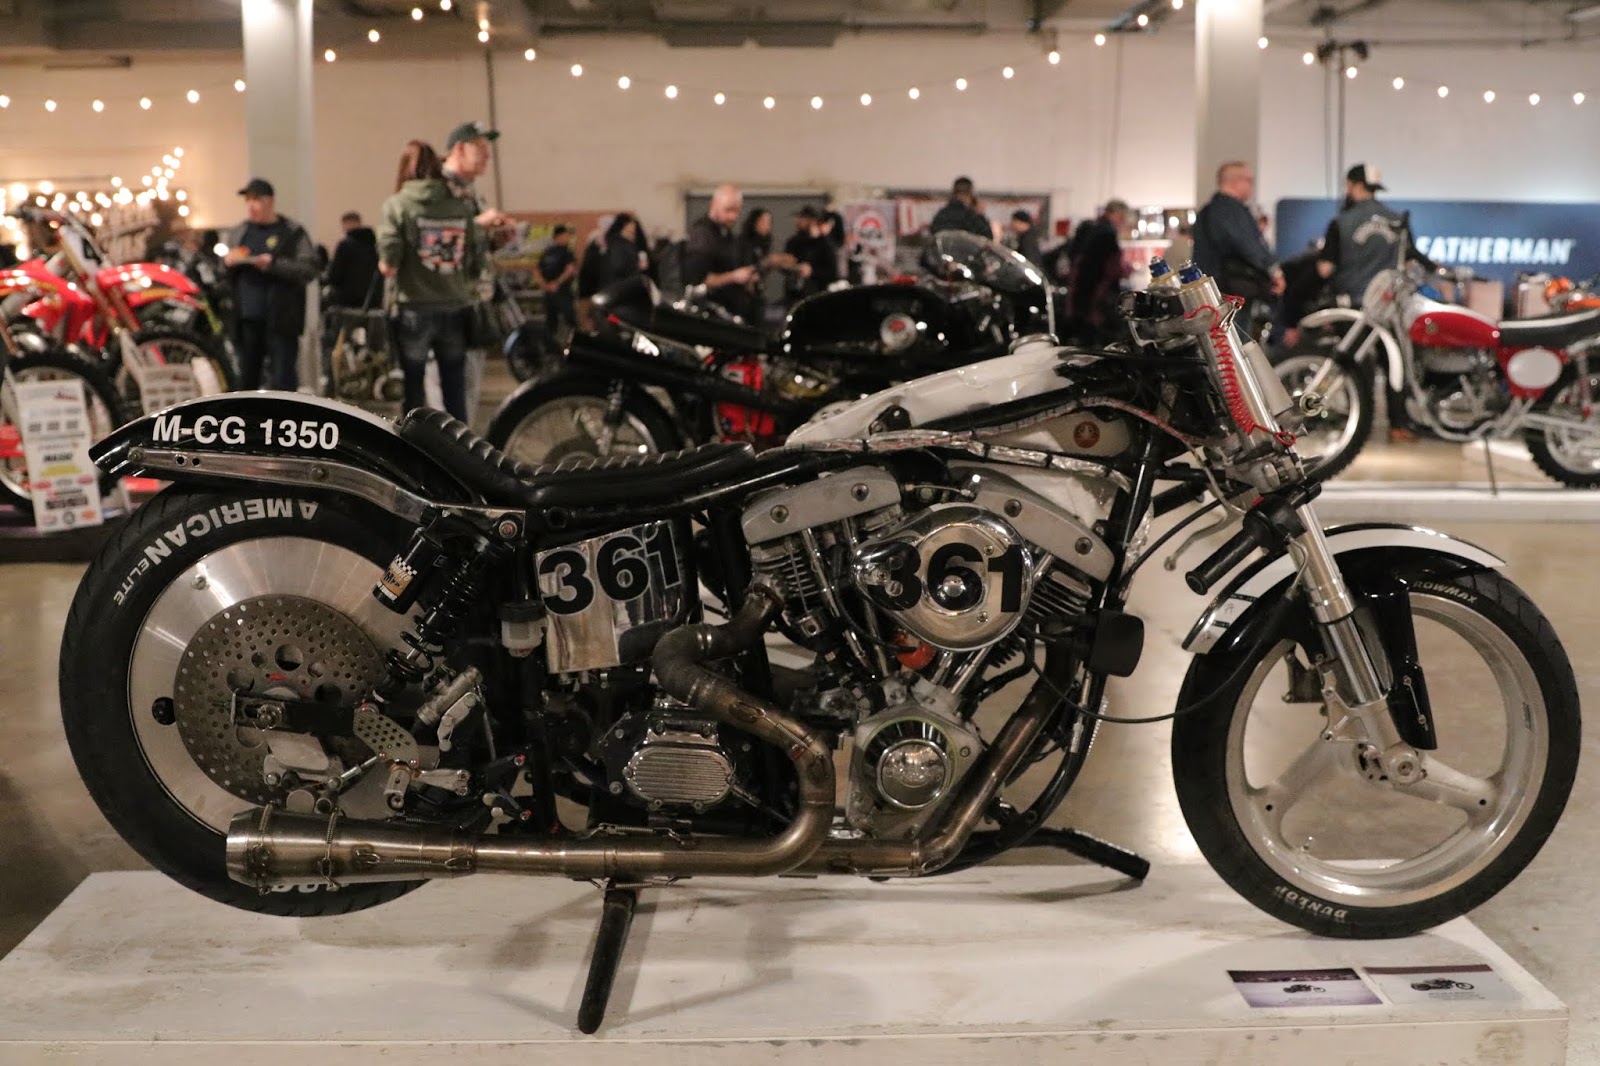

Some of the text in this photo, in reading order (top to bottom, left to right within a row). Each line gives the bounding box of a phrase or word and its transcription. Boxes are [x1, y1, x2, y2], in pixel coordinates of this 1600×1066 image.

[1415, 235, 1571, 265] EATHERMAN
[152, 415, 340, 450] M-CG 1350
[113, 498, 319, 606] AMERICAN ELITE
[538, 520, 682, 617] 361
[867, 542, 1023, 613] 361
[1413, 581, 1478, 604] ROWMAX
[1274, 885, 1348, 920] DUNLOP
